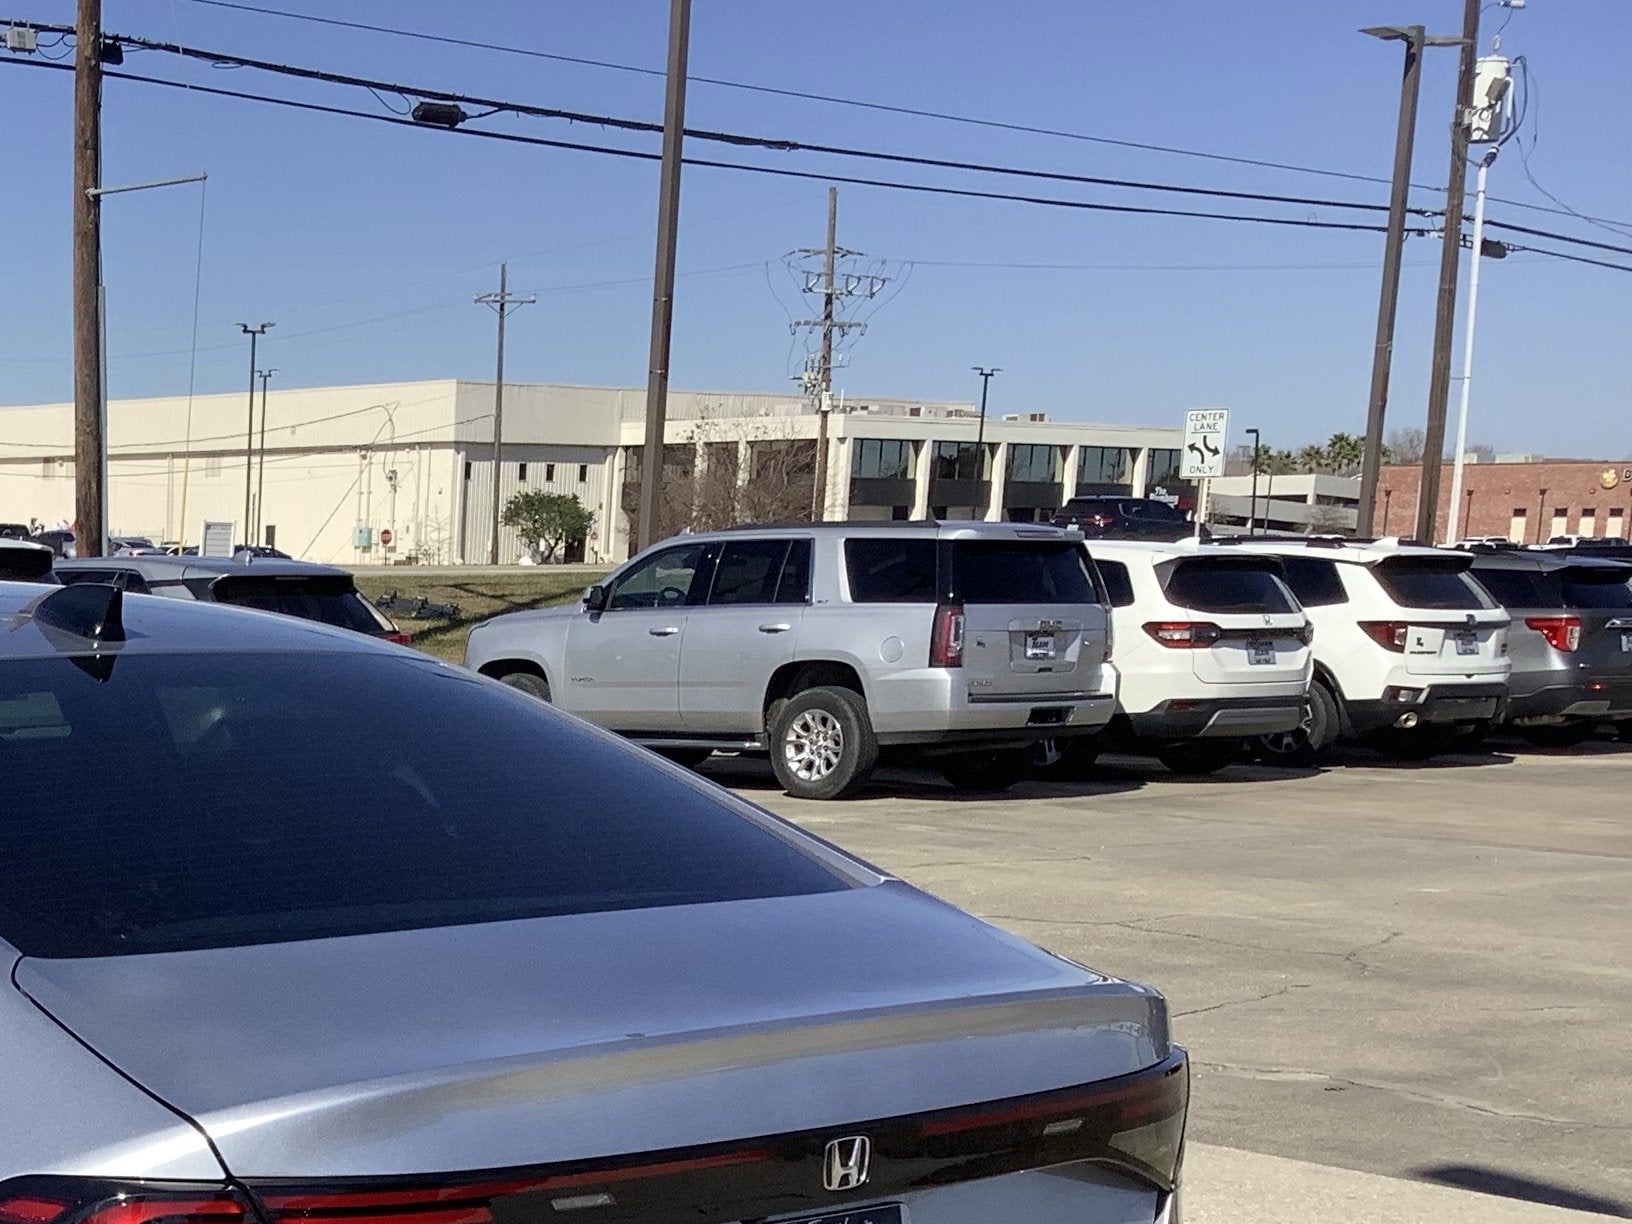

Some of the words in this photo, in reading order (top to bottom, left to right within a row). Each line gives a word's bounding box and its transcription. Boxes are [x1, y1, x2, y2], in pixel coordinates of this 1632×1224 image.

[1189, 412, 1225, 421] CENTER
[1194, 422, 1218, 431] LANE
[1189, 465, 1215, 474] ONLY
